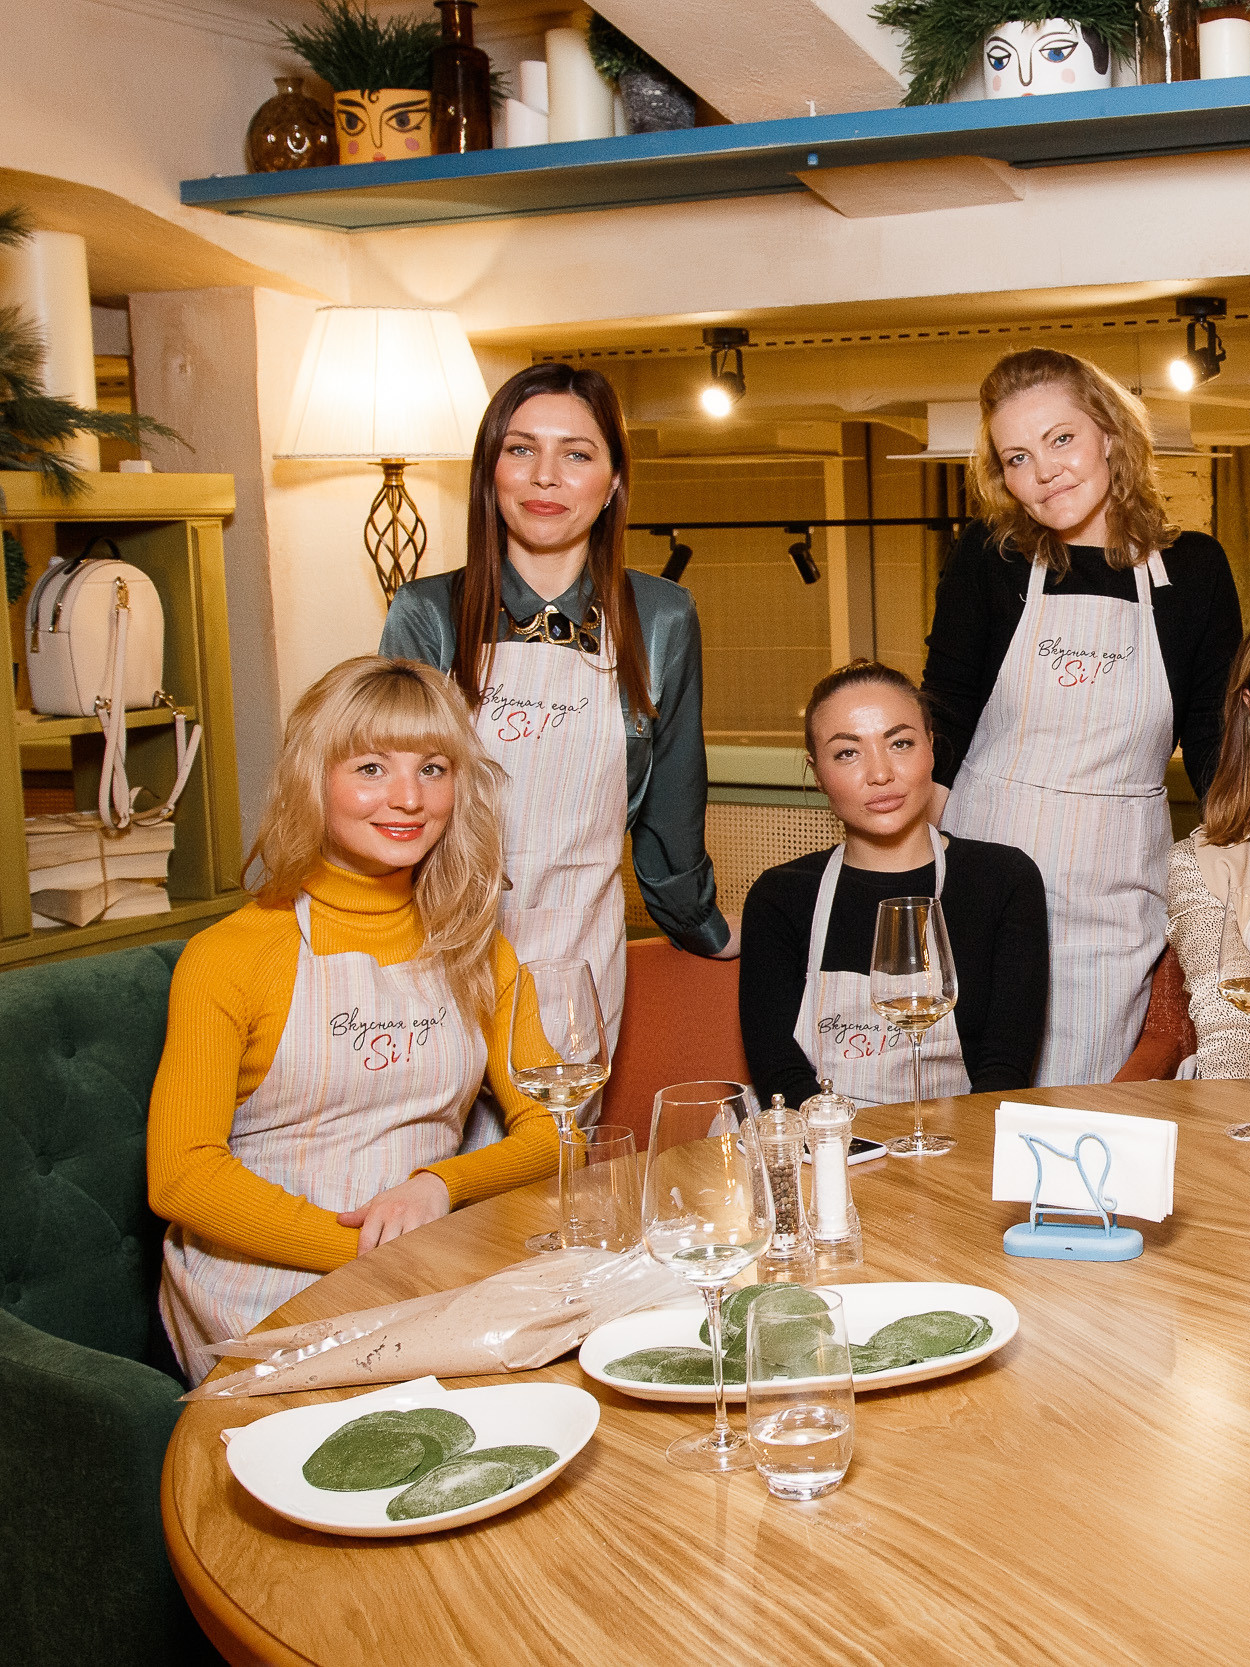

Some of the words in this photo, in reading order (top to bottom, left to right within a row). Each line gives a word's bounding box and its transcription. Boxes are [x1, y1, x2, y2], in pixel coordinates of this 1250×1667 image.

[1038, 636, 1099, 671] Вкусная
[1102, 645, 1134, 674] еда?
[1058, 659, 1102, 687] Si!
[497, 710, 551, 742] Si!
[551, 697, 589, 728] еда?
[329, 1006, 407, 1051] Вкусная
[412, 1006, 447, 1046] еда?
[817, 1013, 882, 1044] Вкусная
[363, 1031, 414, 1071] Si!
[843, 1034, 887, 1060] Si!
